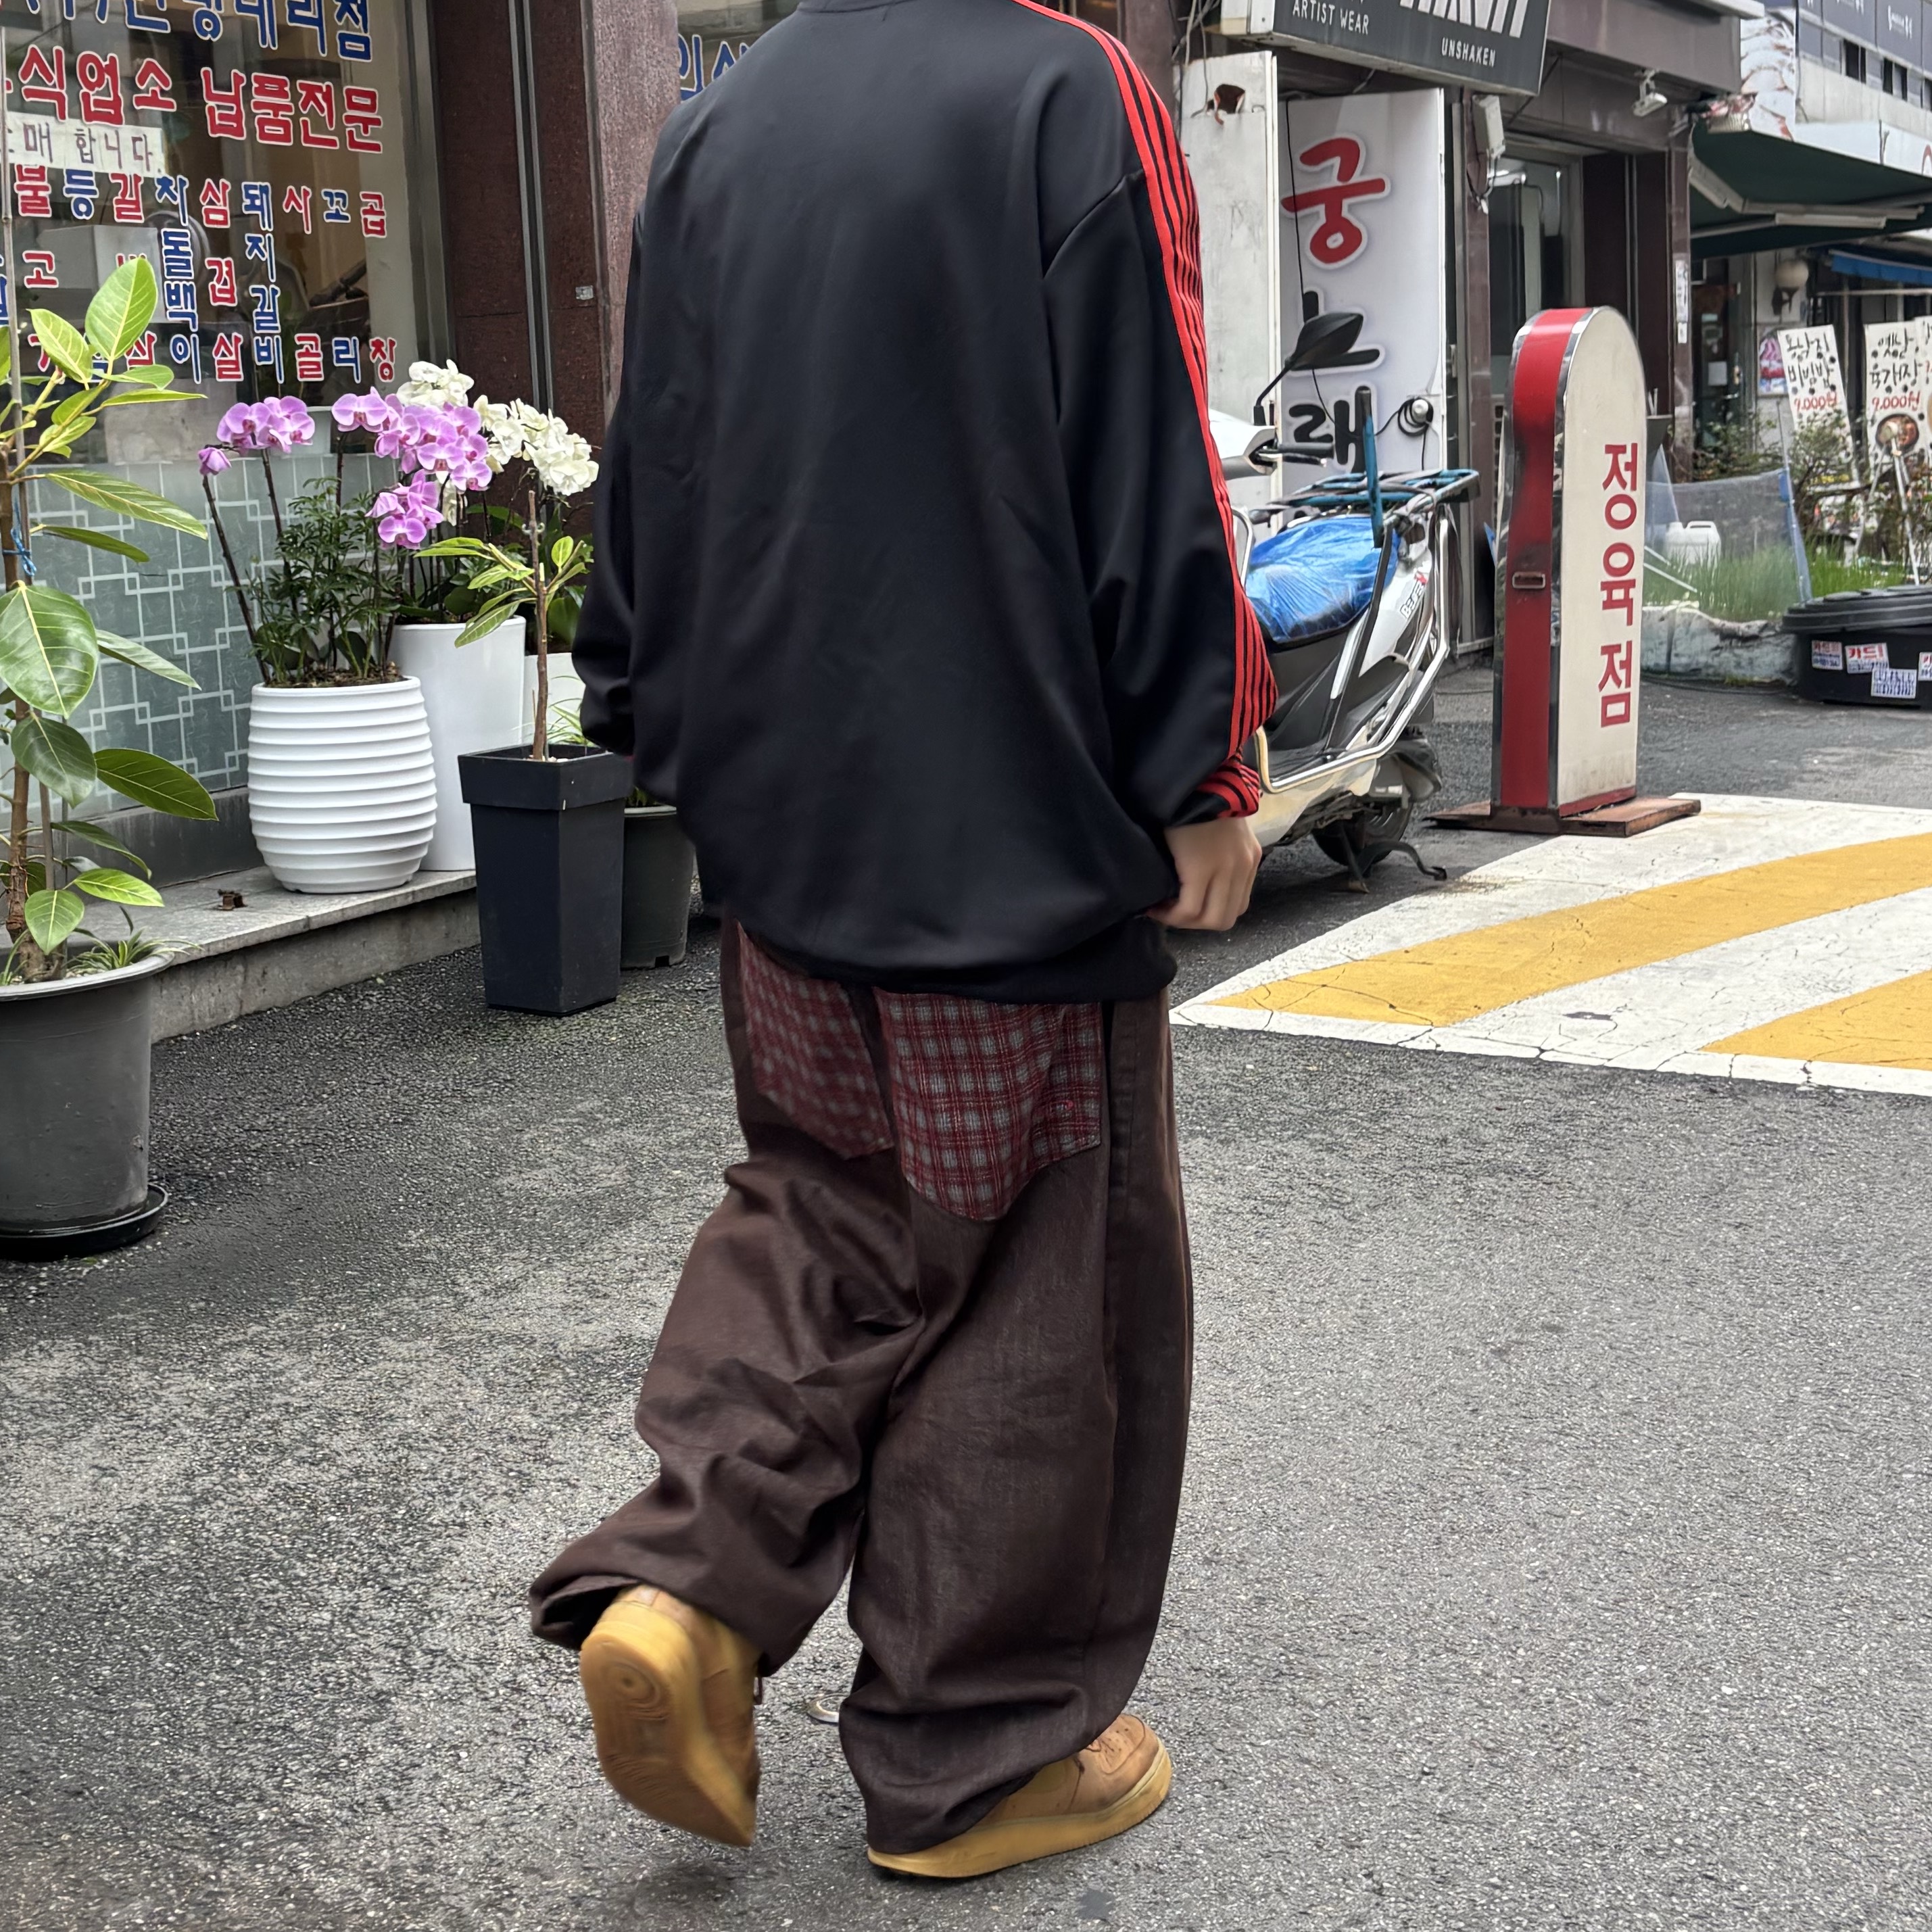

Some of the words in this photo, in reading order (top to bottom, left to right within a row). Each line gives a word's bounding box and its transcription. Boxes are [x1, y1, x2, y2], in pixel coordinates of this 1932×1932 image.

[1292, 0, 1336, 26] ARTIST
[1340, 11, 1370, 35] WEAR
[1441, 37, 1497, 68] UNSHAKEN
[5, 45, 176, 126] 식업소
[201, 67, 383, 153] 납품전문
[241, 180, 285, 385] 돼지갈비
[1598, 442, 1639, 728] 정육점
